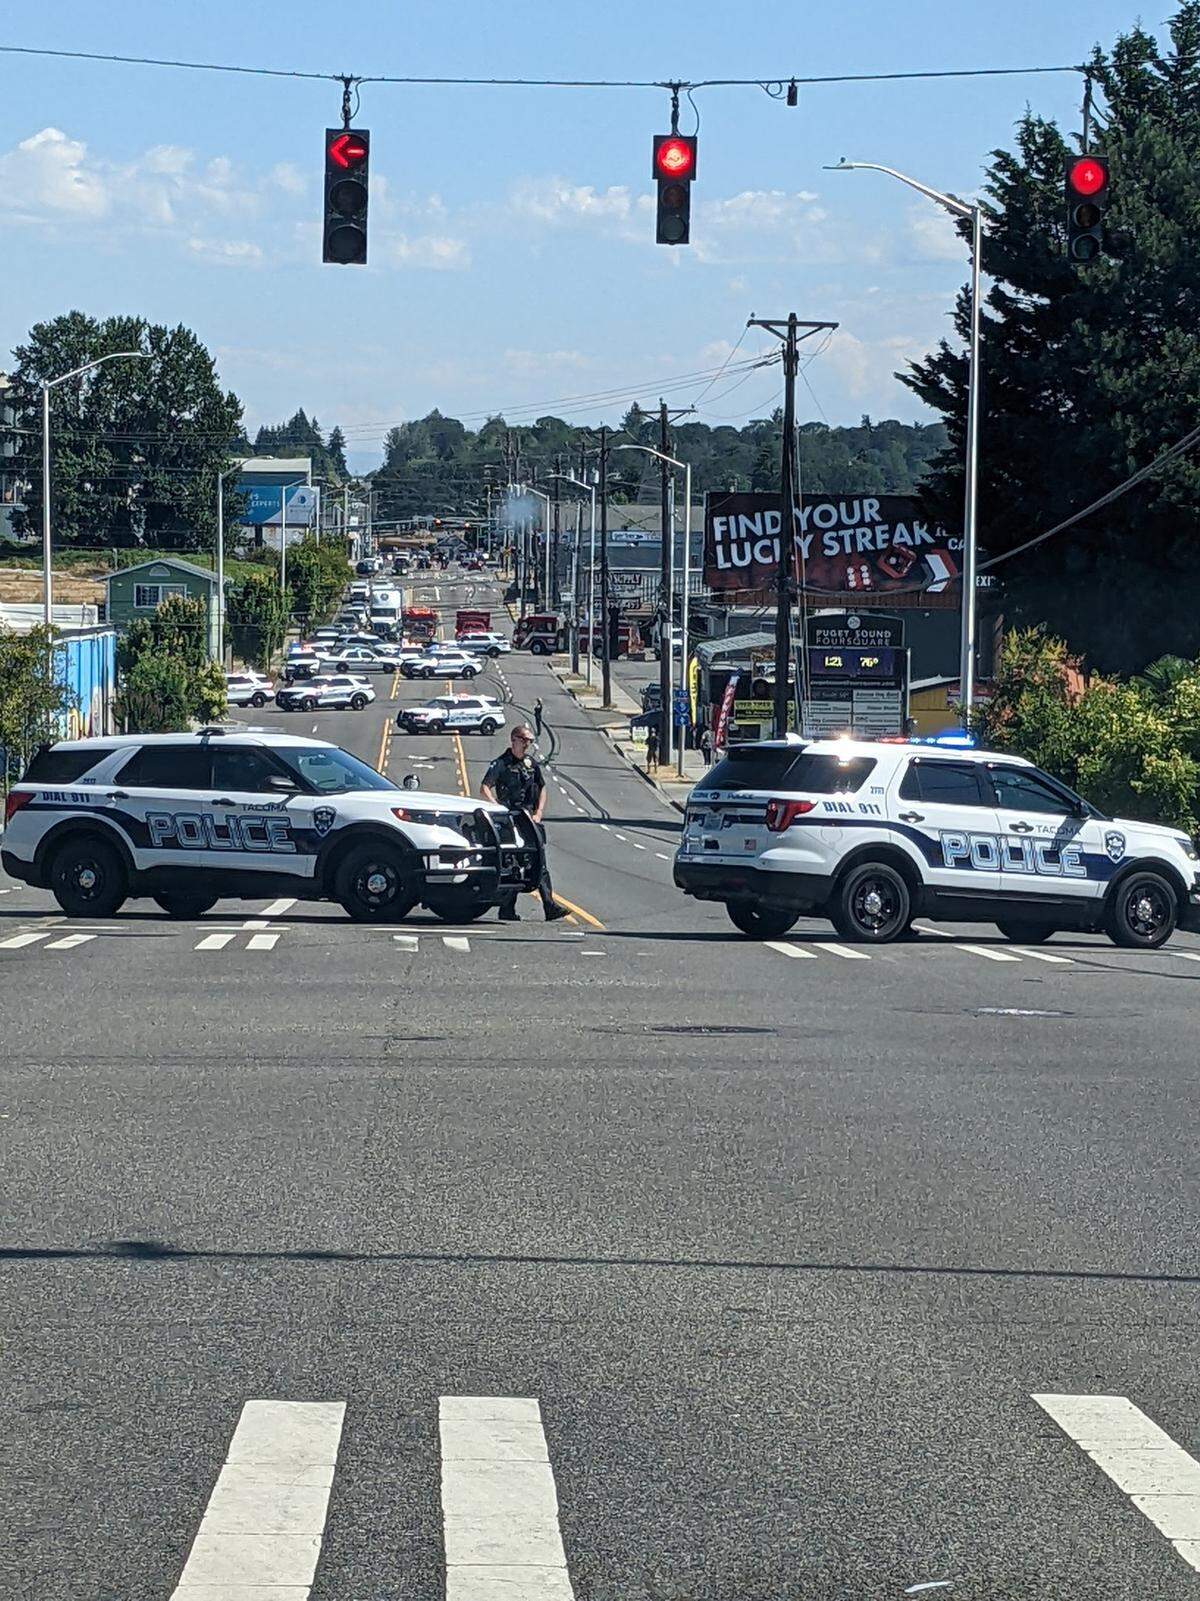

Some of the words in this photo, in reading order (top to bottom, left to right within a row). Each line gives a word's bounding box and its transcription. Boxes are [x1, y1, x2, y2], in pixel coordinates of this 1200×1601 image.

[713, 510, 781, 541] FIND
[793, 498, 882, 531] YOUR
[823, 521, 935, 556] STREAK
[816, 629, 849, 637] PUGET
[855, 630, 892, 638] SOUND
[816, 637, 891, 646] FOURSQUARE
[42, 791, 67, 802] DIAL
[70, 792, 90, 803] 911
[241, 804, 288, 813] TACOMA
[822, 801, 855, 813] DIAL
[858, 803, 881, 815] 911
[145, 811, 297, 853] POLICE
[1035, 824, 1081, 835] TACOMA
[938, 829, 1088, 878] POLICE
